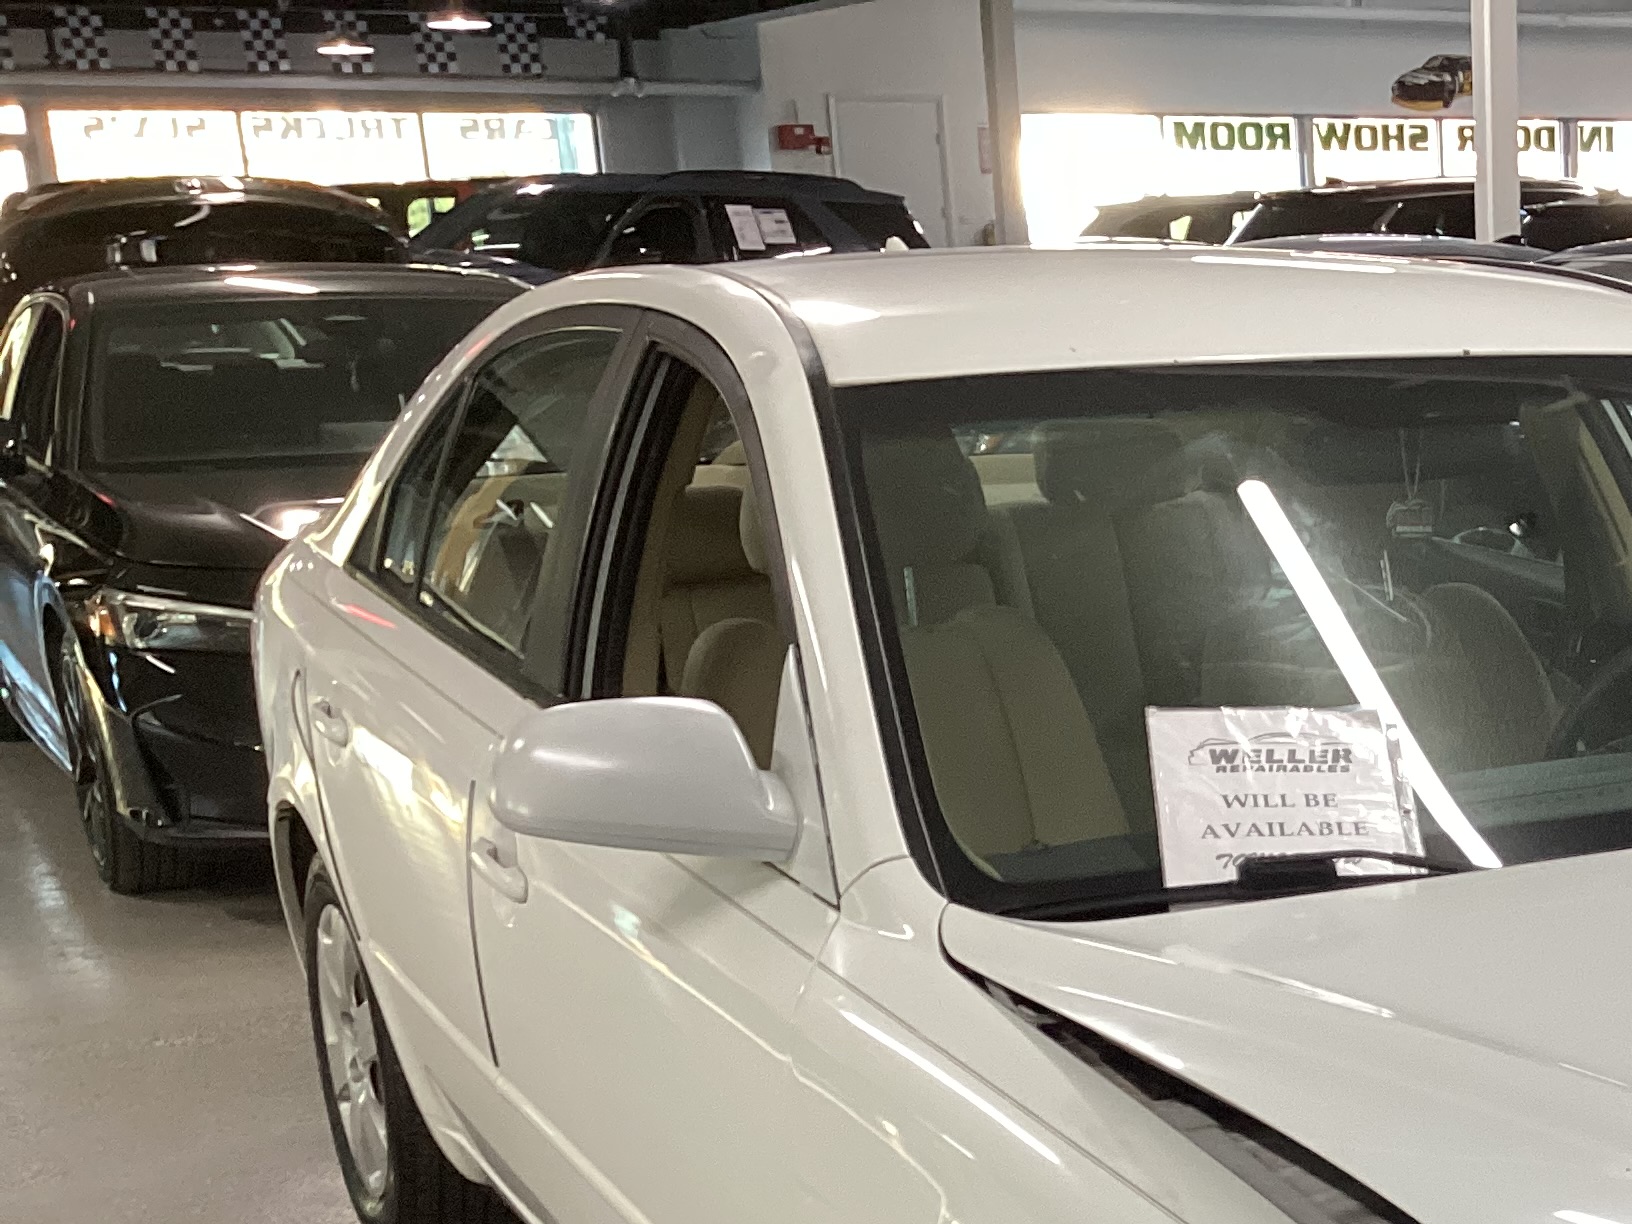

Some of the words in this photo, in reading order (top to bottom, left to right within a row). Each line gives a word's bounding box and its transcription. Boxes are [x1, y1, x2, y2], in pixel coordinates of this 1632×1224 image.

[1209, 748, 1353, 764] WELLER
[1222, 793, 1296, 808] WILL
[1304, 793, 1339, 808] BE
[1201, 821, 1370, 839] AVAILABLE
